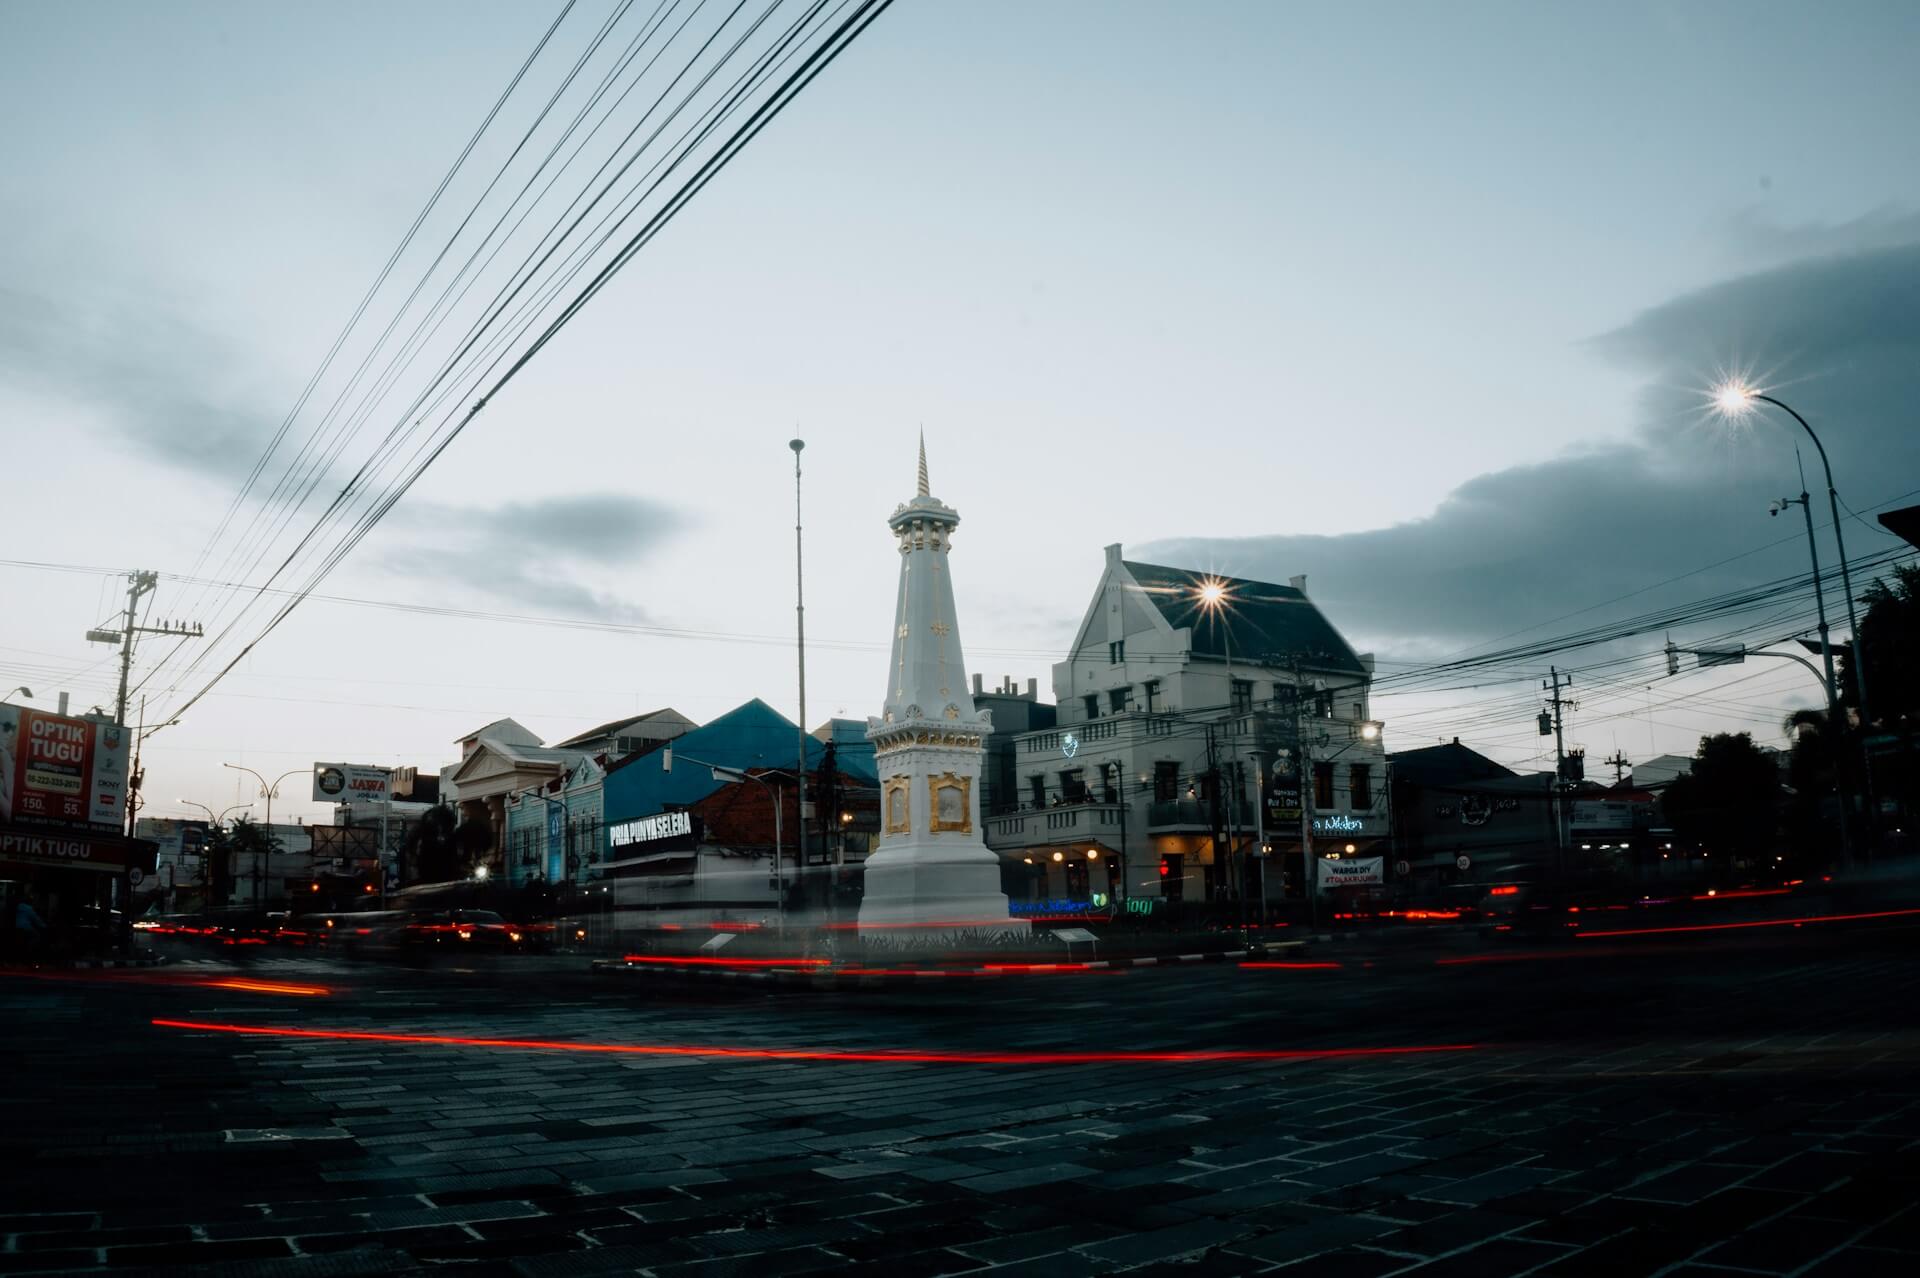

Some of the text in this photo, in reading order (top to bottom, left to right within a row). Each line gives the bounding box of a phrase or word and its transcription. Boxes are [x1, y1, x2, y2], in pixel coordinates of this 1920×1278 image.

[31, 719, 85, 743] OPTIK
[30, 738, 83, 762] TUGU
[348, 779, 385, 792] JAWA
[609, 811, 692, 847] PRIA PUNYA SELERA
[0, 833, 91, 859] PTIK TUGU
[1360, 865, 1371, 873] DIY
